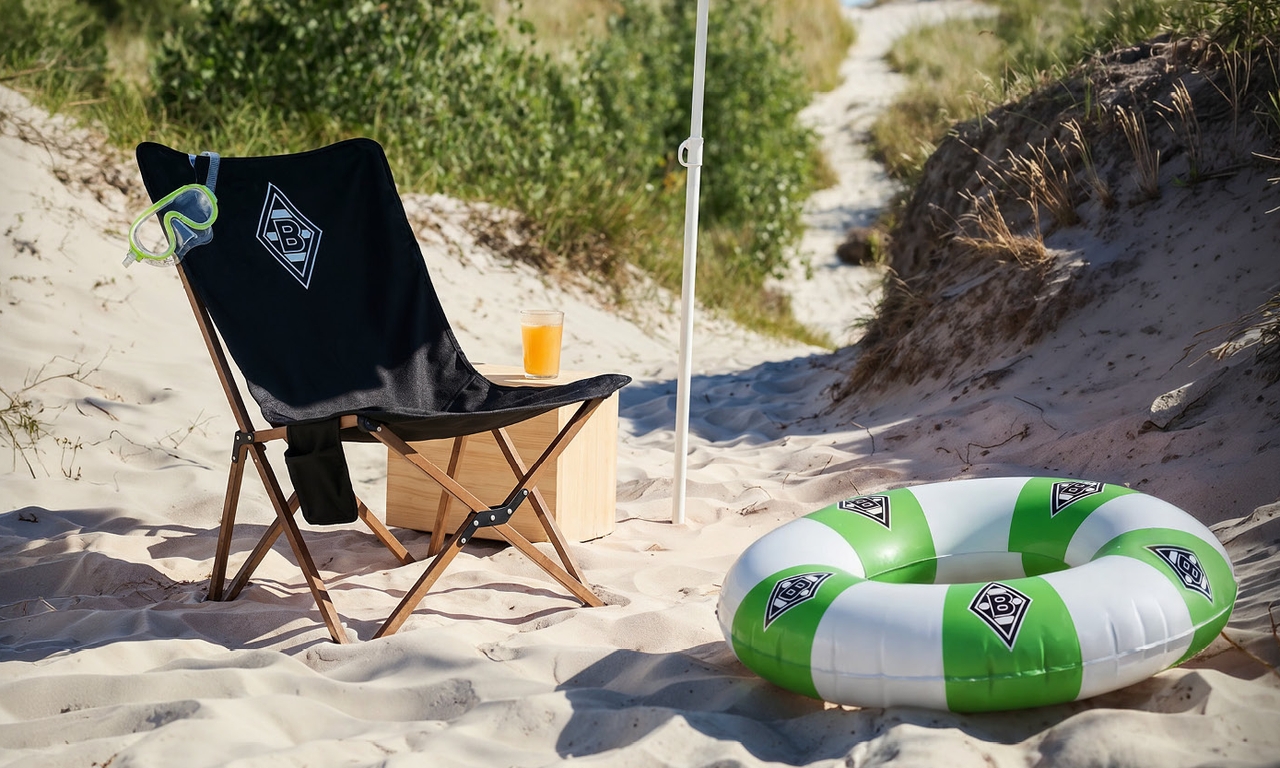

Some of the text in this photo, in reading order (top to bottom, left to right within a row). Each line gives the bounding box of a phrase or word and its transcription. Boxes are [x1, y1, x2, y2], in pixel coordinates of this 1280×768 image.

[273, 218, 306, 254] B
[1177, 553, 1203, 585] B
[778, 577, 813, 602] B
[986, 592, 1016, 618] B
